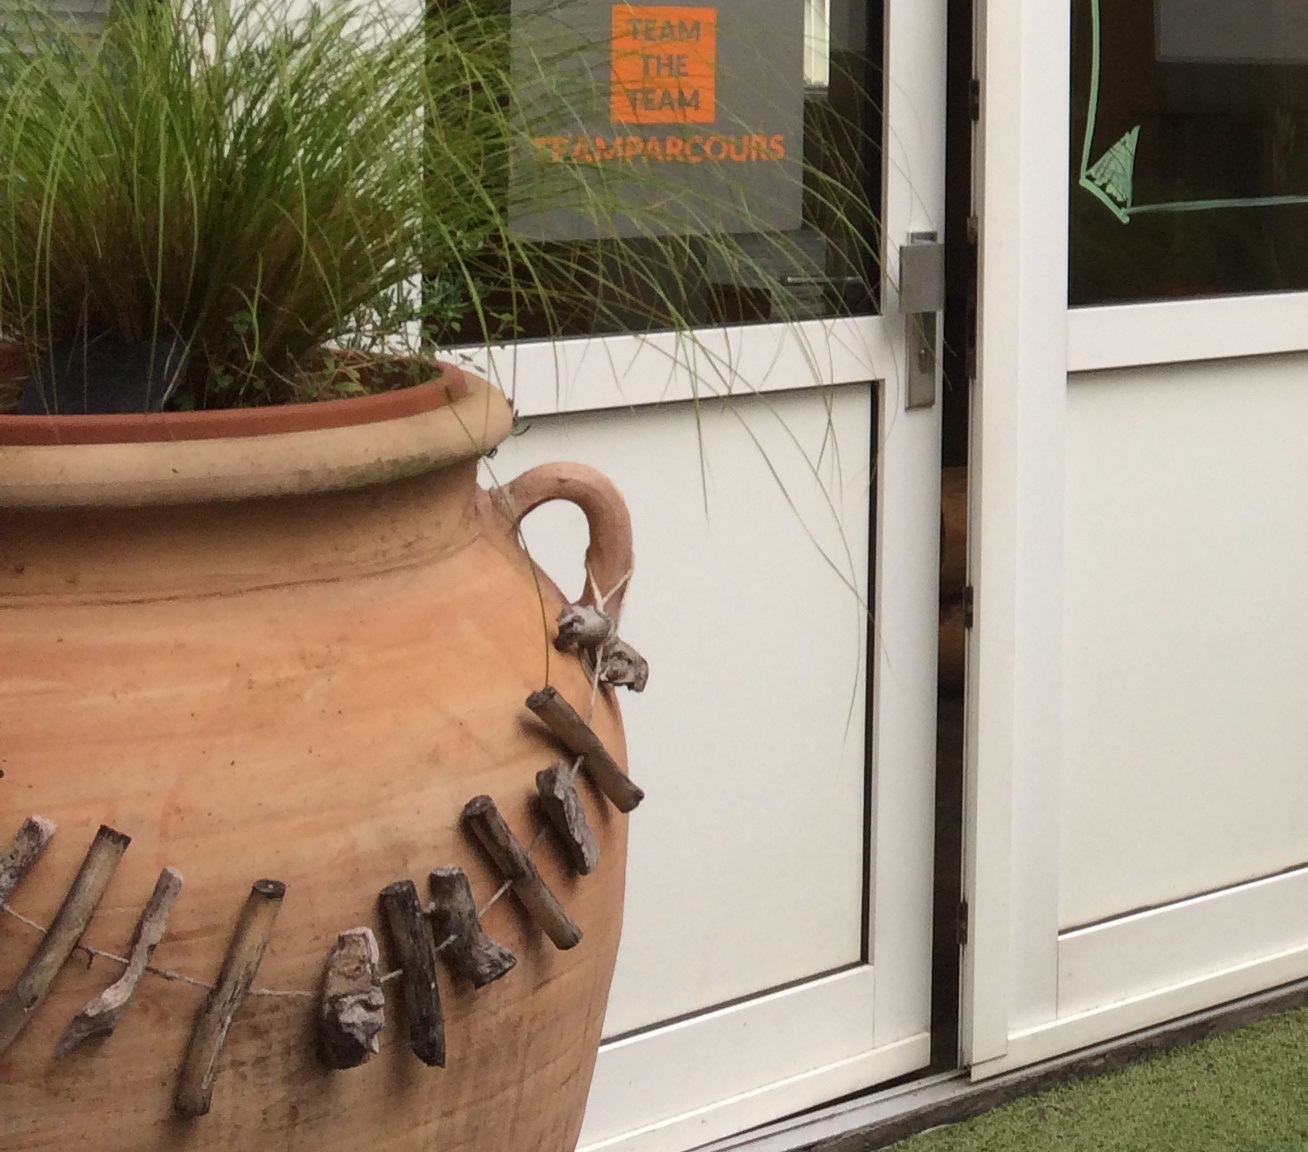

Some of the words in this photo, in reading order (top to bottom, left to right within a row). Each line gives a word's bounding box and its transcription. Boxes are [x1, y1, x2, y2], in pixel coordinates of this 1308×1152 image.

[627, 18, 700, 42] TEAM
[641, 54, 688, 77] THE
[626, 88, 700, 111] TEAM
[534, 134, 786, 163] TEAMPARCOURS
